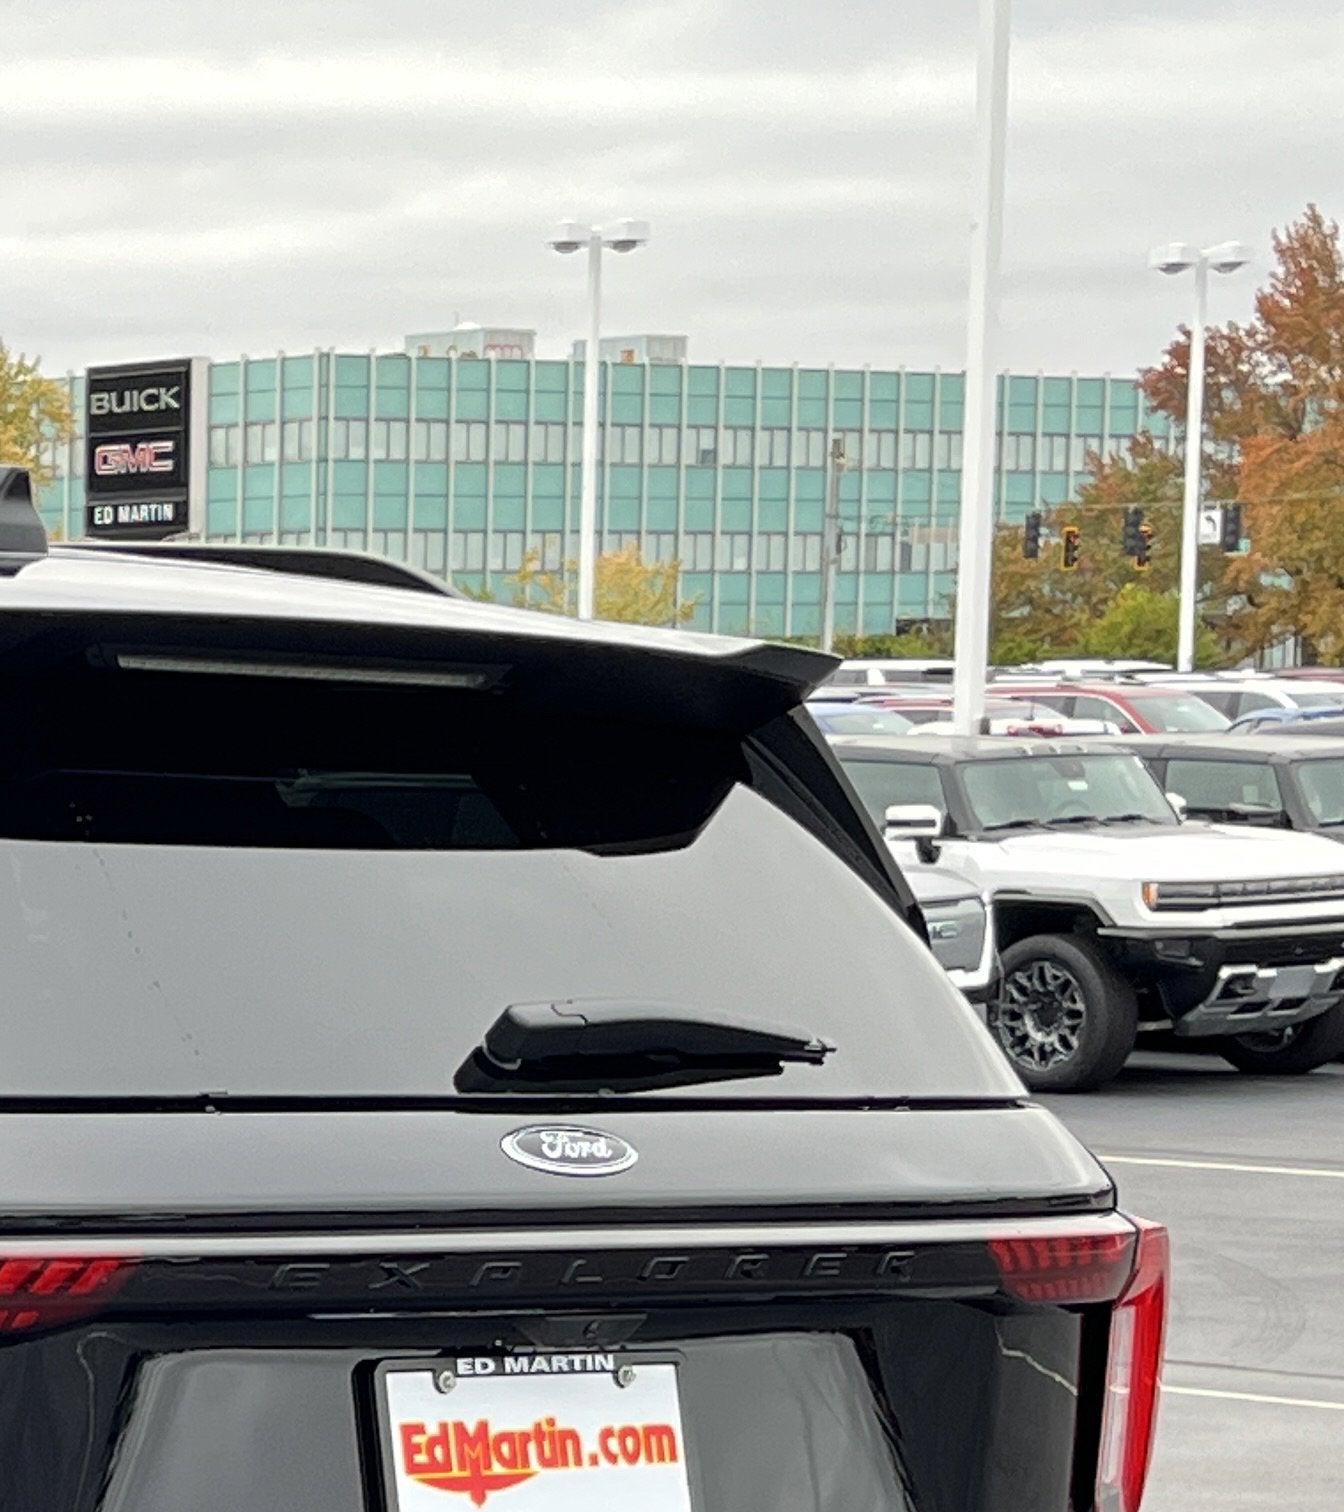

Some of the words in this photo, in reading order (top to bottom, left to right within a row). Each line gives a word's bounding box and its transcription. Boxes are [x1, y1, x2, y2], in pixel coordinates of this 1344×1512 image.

[90, 386, 180, 415] BUICK
[94, 440, 174, 475] GMC
[93, 504, 112, 525] ED
[117, 503, 173, 523] MARTIN
[540, 1131, 613, 1158] Ford
[269, 1251, 915, 1290] EXPLORER
[456, 1357, 495, 1376] ED
[504, 1354, 615, 1374] MARTIN
[399, 1416, 678, 1476] EdMartin.com
